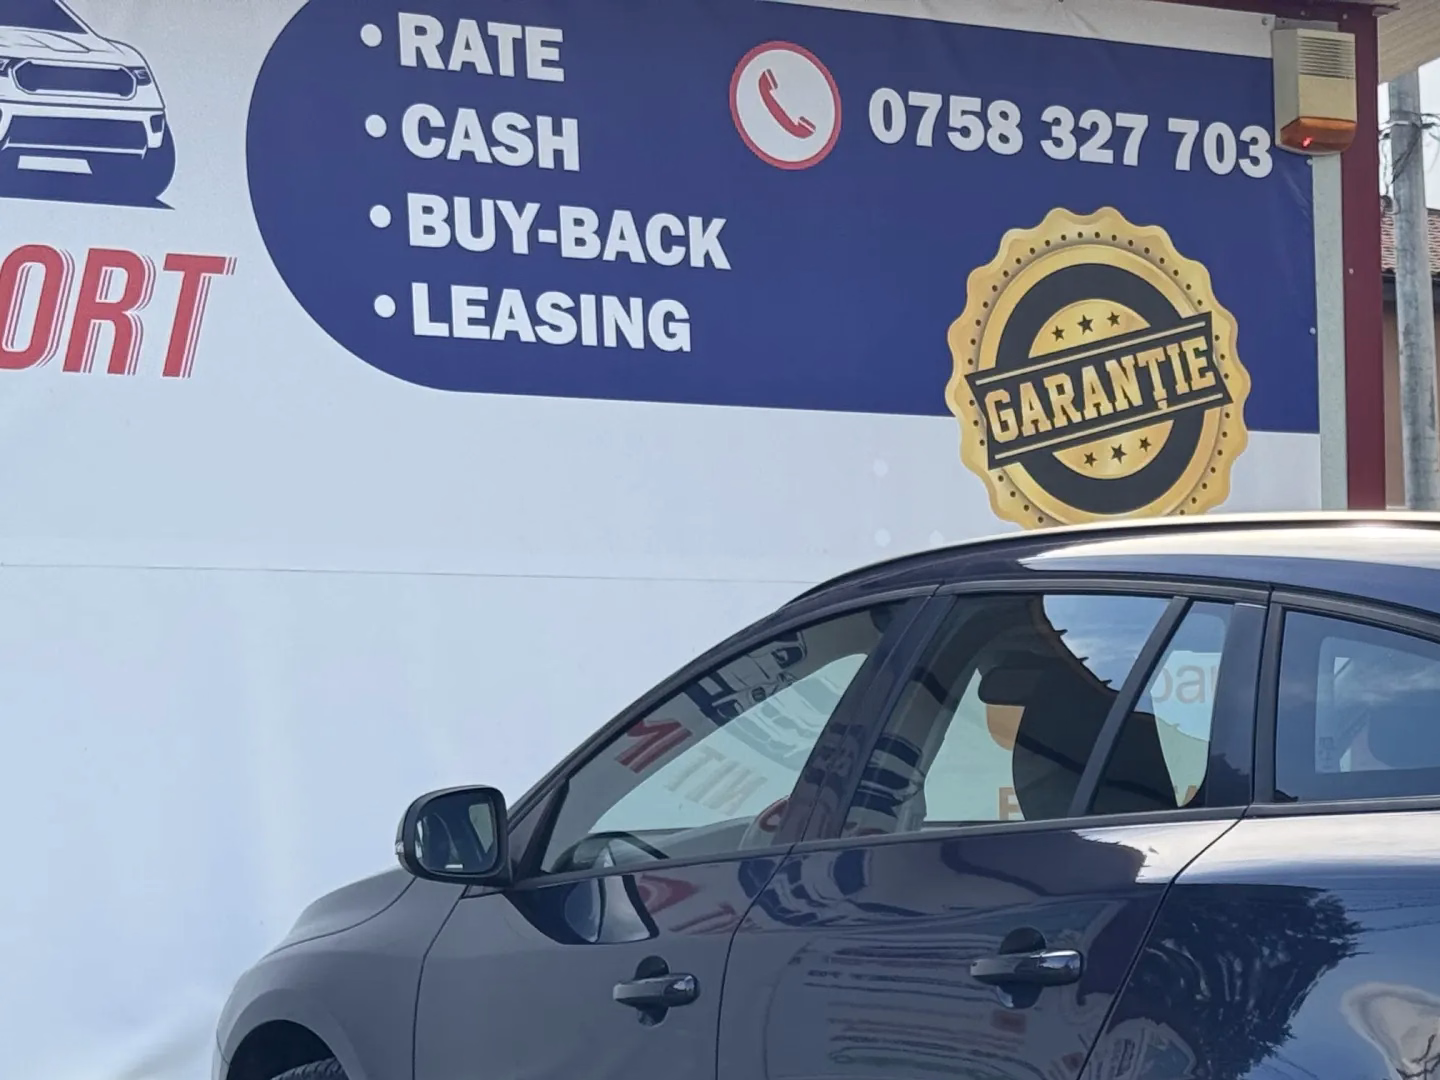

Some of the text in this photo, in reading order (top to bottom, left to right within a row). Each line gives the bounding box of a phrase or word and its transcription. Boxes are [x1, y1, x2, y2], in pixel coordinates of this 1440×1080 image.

[399, 12, 564, 81] RATE
[402, 104, 579, 170] CASH
[869, 88, 1272, 177] 0758 327 703
[408, 193, 730, 269] BUY-BACK
[412, 283, 690, 351] LEASING
[985, 336, 1216, 443] GARANȚIE
